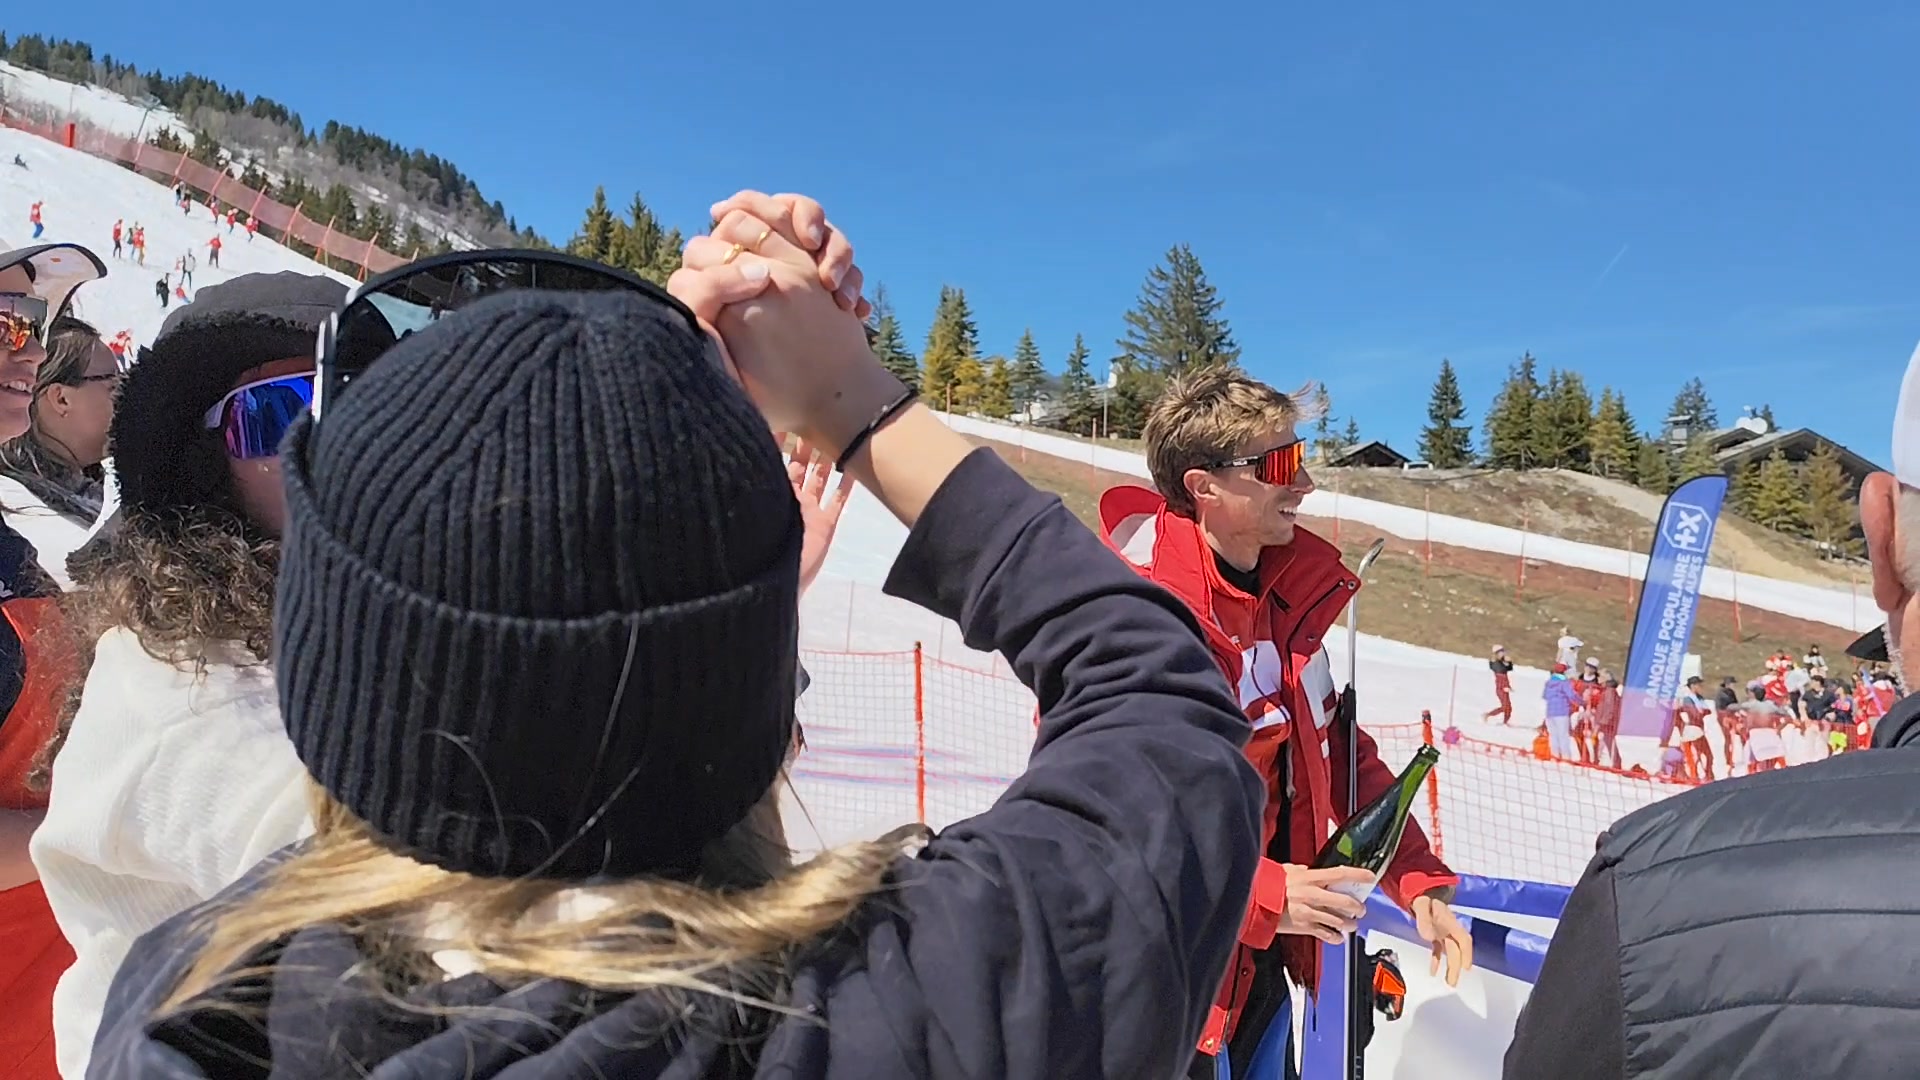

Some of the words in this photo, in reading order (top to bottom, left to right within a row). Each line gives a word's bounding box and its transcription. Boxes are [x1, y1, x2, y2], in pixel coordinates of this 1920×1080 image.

[1643, 643, 1669, 708] BANQUE
[1658, 553, 1690, 641] POPULAIRE
[1659, 641, 1683, 708] AUVERGNE
[1685, 555, 1703, 594] ALPES
